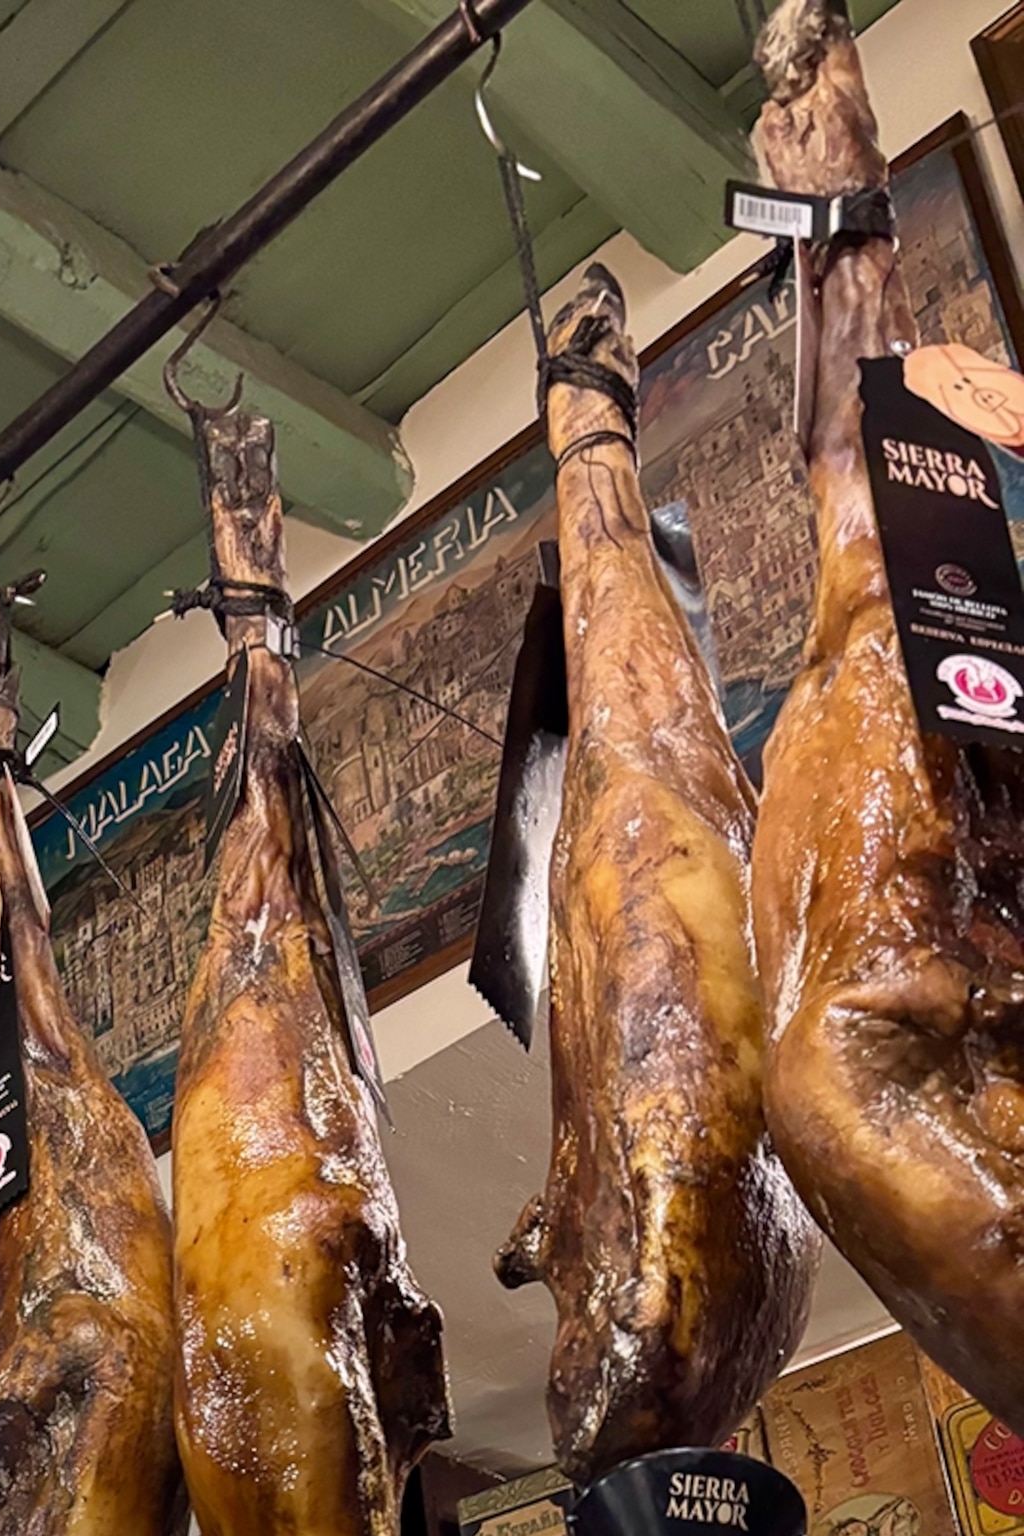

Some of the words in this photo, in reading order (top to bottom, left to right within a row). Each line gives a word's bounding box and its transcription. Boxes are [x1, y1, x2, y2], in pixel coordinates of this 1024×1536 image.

[882, 438, 986, 481] SIERRA
[887, 460, 1000, 510] MAYOR
[669, 1472, 750, 1504] SIERRA
[666, 1497, 749, 1531] MAYOR
